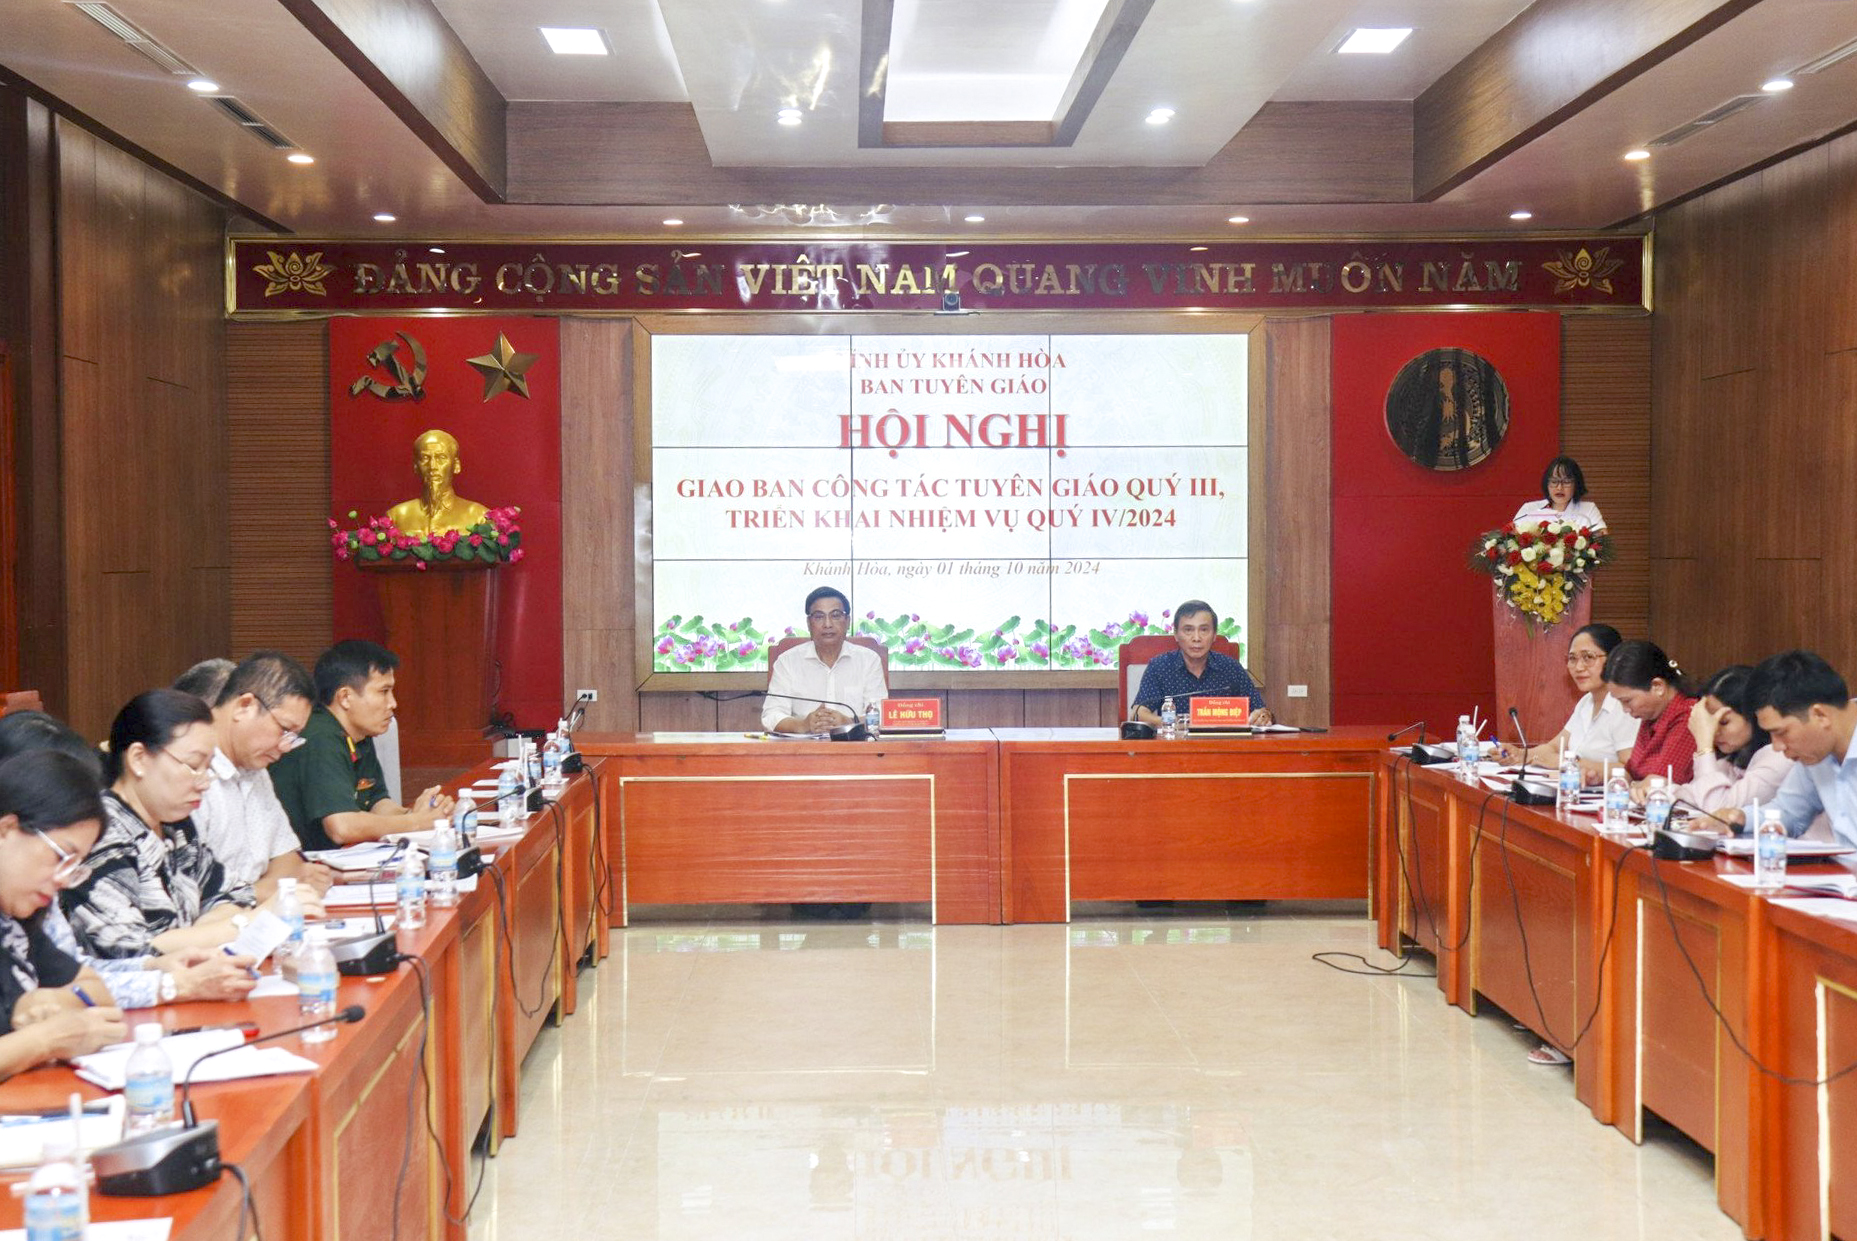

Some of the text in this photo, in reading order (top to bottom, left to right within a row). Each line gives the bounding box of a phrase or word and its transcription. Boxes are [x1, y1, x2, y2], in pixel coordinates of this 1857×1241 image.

[352, 249, 1523, 302] ĐẢNG CỘNG SẢN VIỆT NAM QUANG VINH MUÔN NĂM
[897, 348, 926, 369] ỦY
[932, 348, 1011, 369] KHÁNH
[1018, 348, 1067, 369] HÒA
[860, 374, 1047, 395] BAN TUYÊN GIÁO
[837, 408, 1070, 459] HỘI NGHỊ
[676, 472, 1225, 500] GIAO BAN CÔNG TÁC TUYÊN GIÁO QUÝ III,
[726, 503, 1176, 533] TRIỂN KHAI NHIỆM VỤ QUÝ IV/2024
[803, 561, 1101, 579] Khánh Hòa, ngày 01 tháng 10 năm 2024
